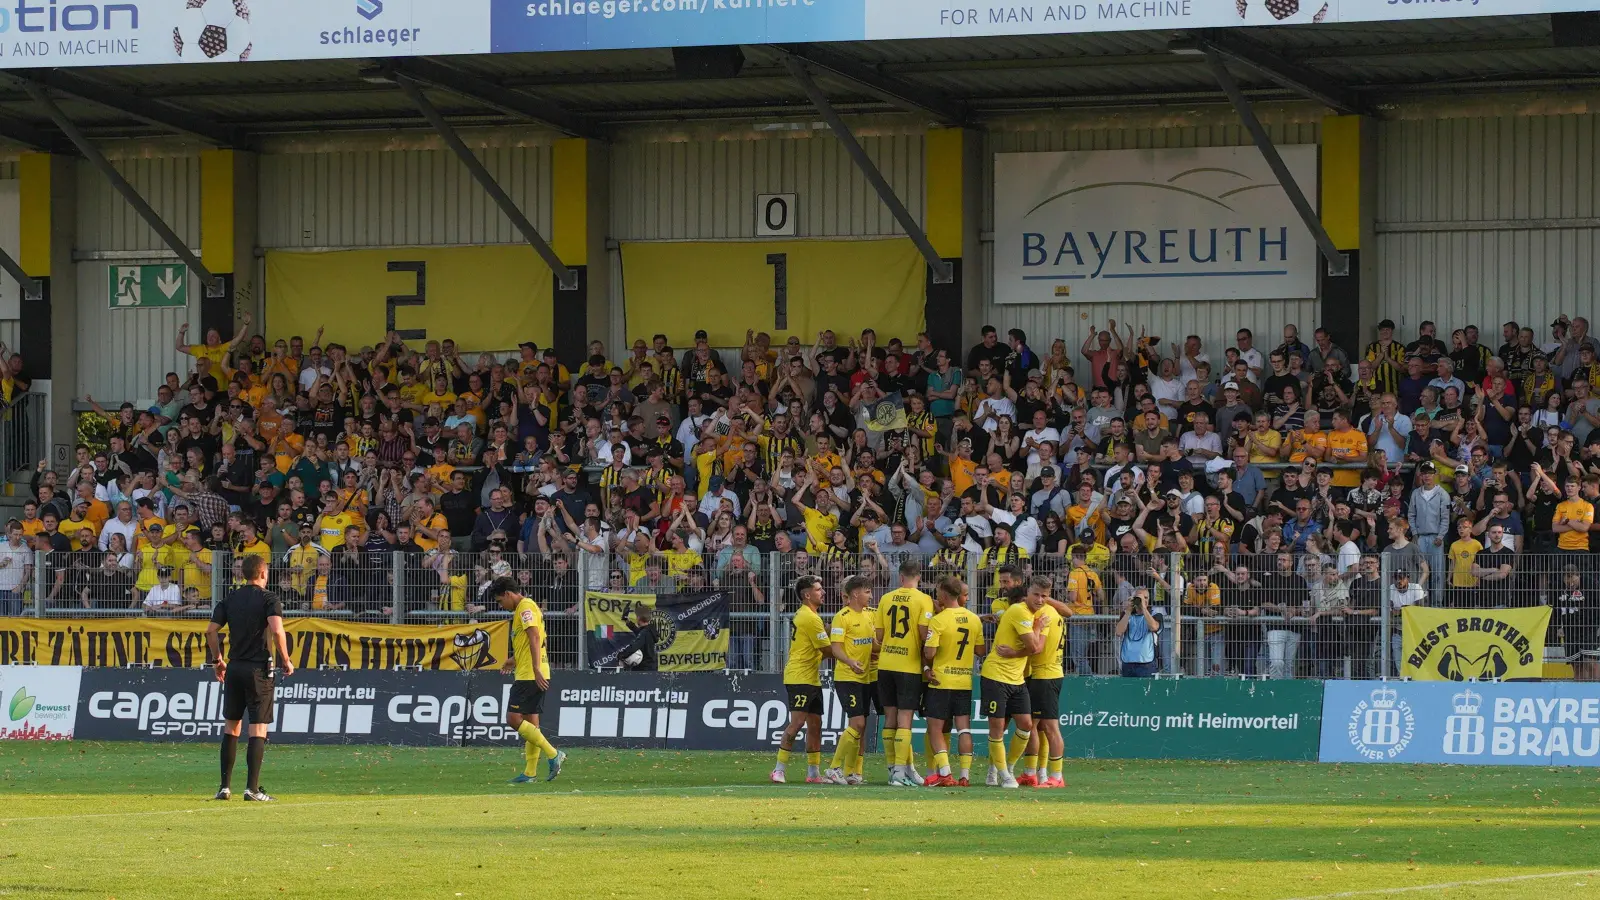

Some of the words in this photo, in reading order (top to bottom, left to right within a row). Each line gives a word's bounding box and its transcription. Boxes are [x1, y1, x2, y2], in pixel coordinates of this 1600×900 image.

[0, 0, 139, 33] tion
[940, 9, 979, 25] FOR
[989, 7, 1034, 23] MAN
[1044, 4, 1087, 21] AND
[1098, 0, 1192, 19] MACHINE
[320, 26, 420, 46] schlaeger
[13, 41, 50, 56] AND
[59, 38, 139, 55] MACHINE
[1022, 226, 1288, 279] BAYREUTH
[387, 261, 427, 340] 2
[766, 253, 787, 330] 1
[588, 598, 643, 613] FORZ
[887, 604, 909, 640] 13
[359, 636, 446, 670] HERZ
[957, 627, 969, 661] 7
[1407, 622, 1449, 669] BIEST
[1456, 617, 1534, 666] BROTHES
[659, 652, 727, 666] BAYREUTH
[274, 683, 376, 702] pellisport.eu
[560, 686, 689, 706] capellisport.eu
[795, 694, 808, 708] 27
[849, 694, 857, 708] 3
[35, 704, 71, 712] Bewusst
[989, 700, 997, 714] 9
[151, 722, 226, 736] SPORT
[1059, 711, 1093, 726] eine
[1097, 711, 1161, 732] Zeitung
[1165, 713, 1194, 729] mit
[1198, 713, 1299, 730] Heimvorteil
[1348, 700, 1385, 761] BAYREUTHER
[1387, 700, 1415, 759] BRAUHAUS
[452, 725, 520, 740] SPOR
